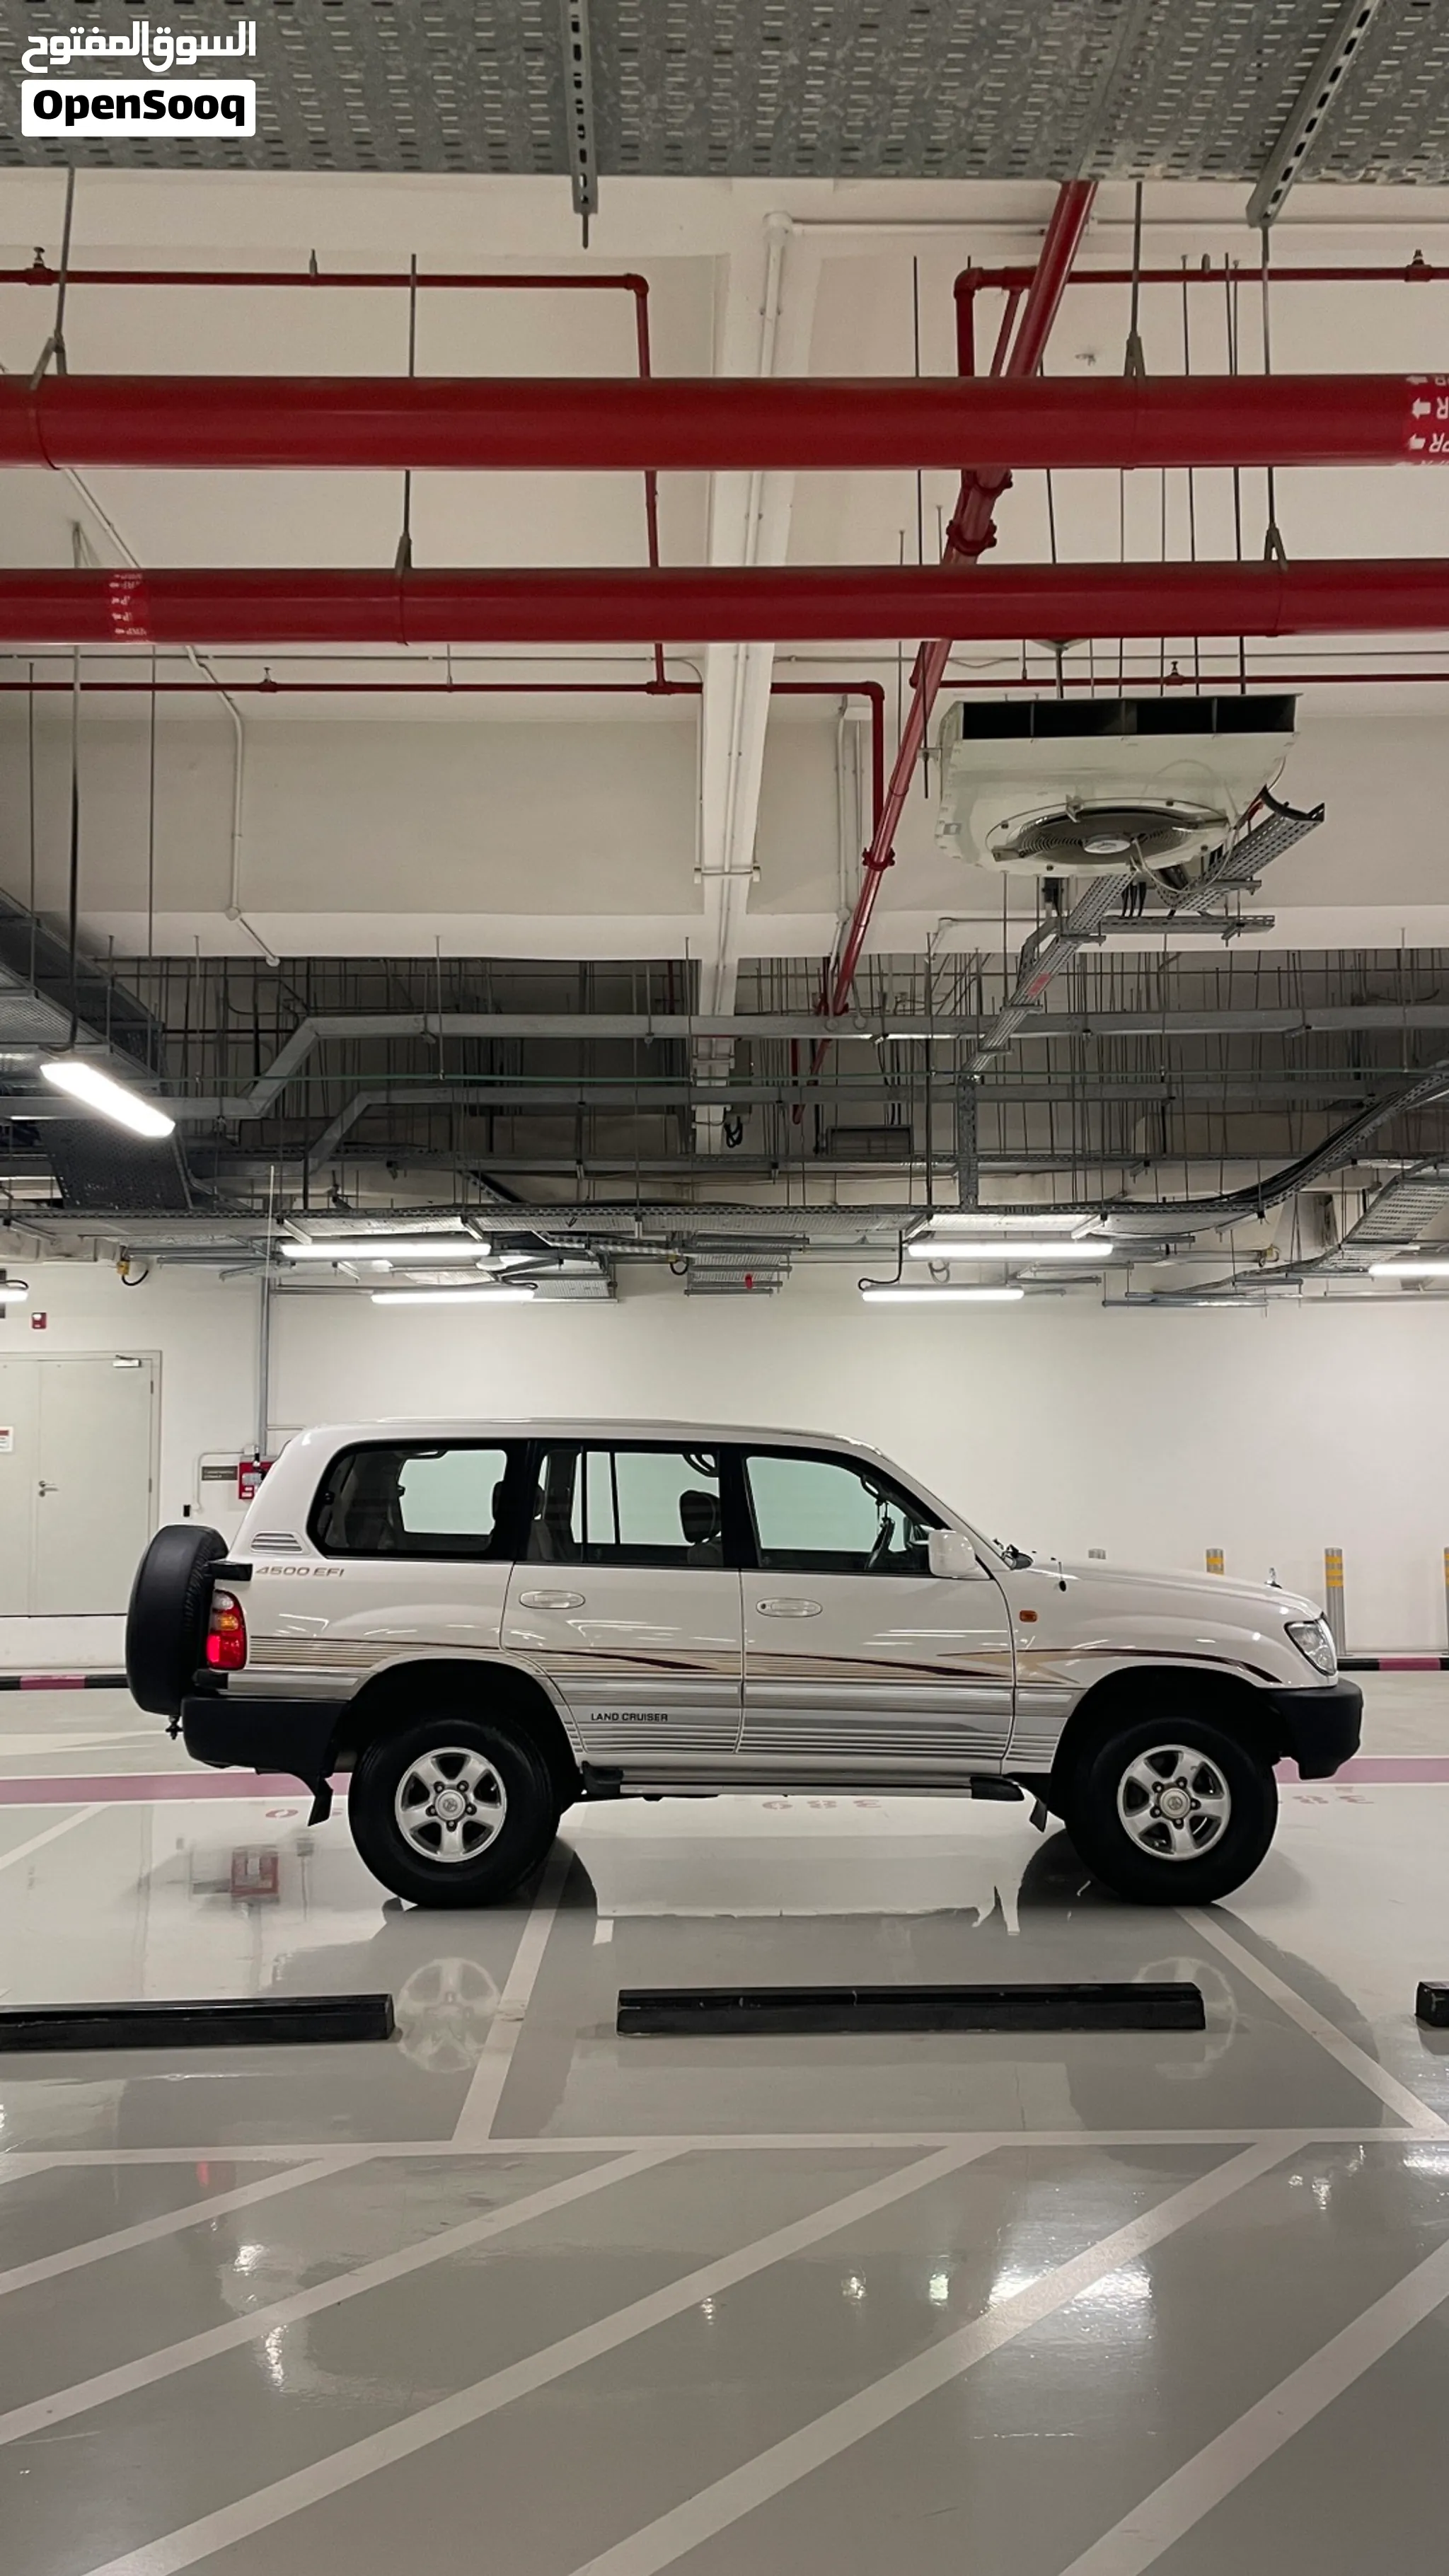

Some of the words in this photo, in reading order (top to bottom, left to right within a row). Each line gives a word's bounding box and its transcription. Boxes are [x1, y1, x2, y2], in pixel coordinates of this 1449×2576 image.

[255, 1566, 310, 1576] 4500
[313, 1566, 345, 1578] EFI
[591, 1712, 619, 1721] LAND
[622, 1712, 669, 1722] CRUISER
